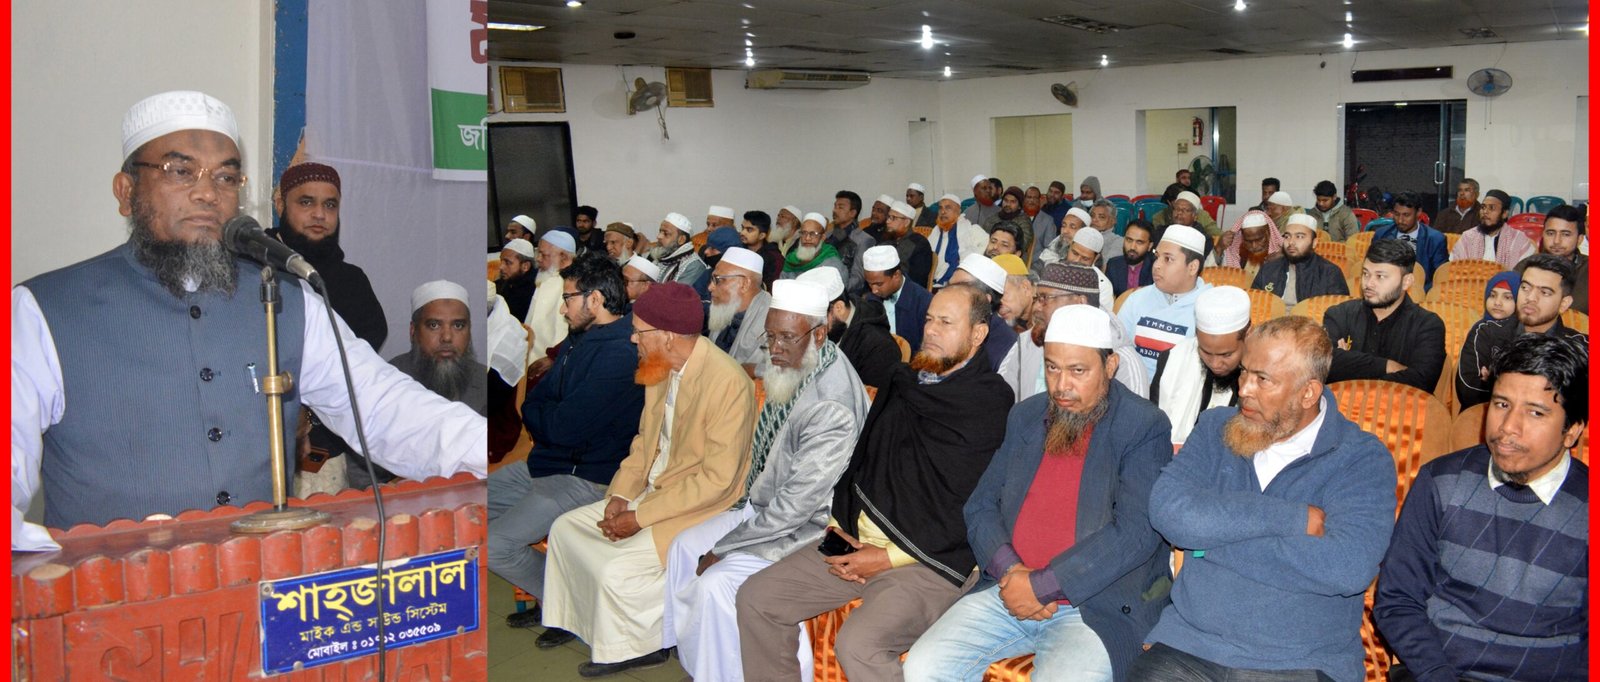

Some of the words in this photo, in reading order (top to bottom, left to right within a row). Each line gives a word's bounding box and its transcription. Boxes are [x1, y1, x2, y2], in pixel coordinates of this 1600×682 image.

[299, 625, 335, 643] মাইক
[341, 619, 363, 634] এন্ড
[367, 611, 402, 629] সউন্ড
[405, 602, 447, 622] সিস্টেম
[307, 640, 349, 660] মোবাইল
